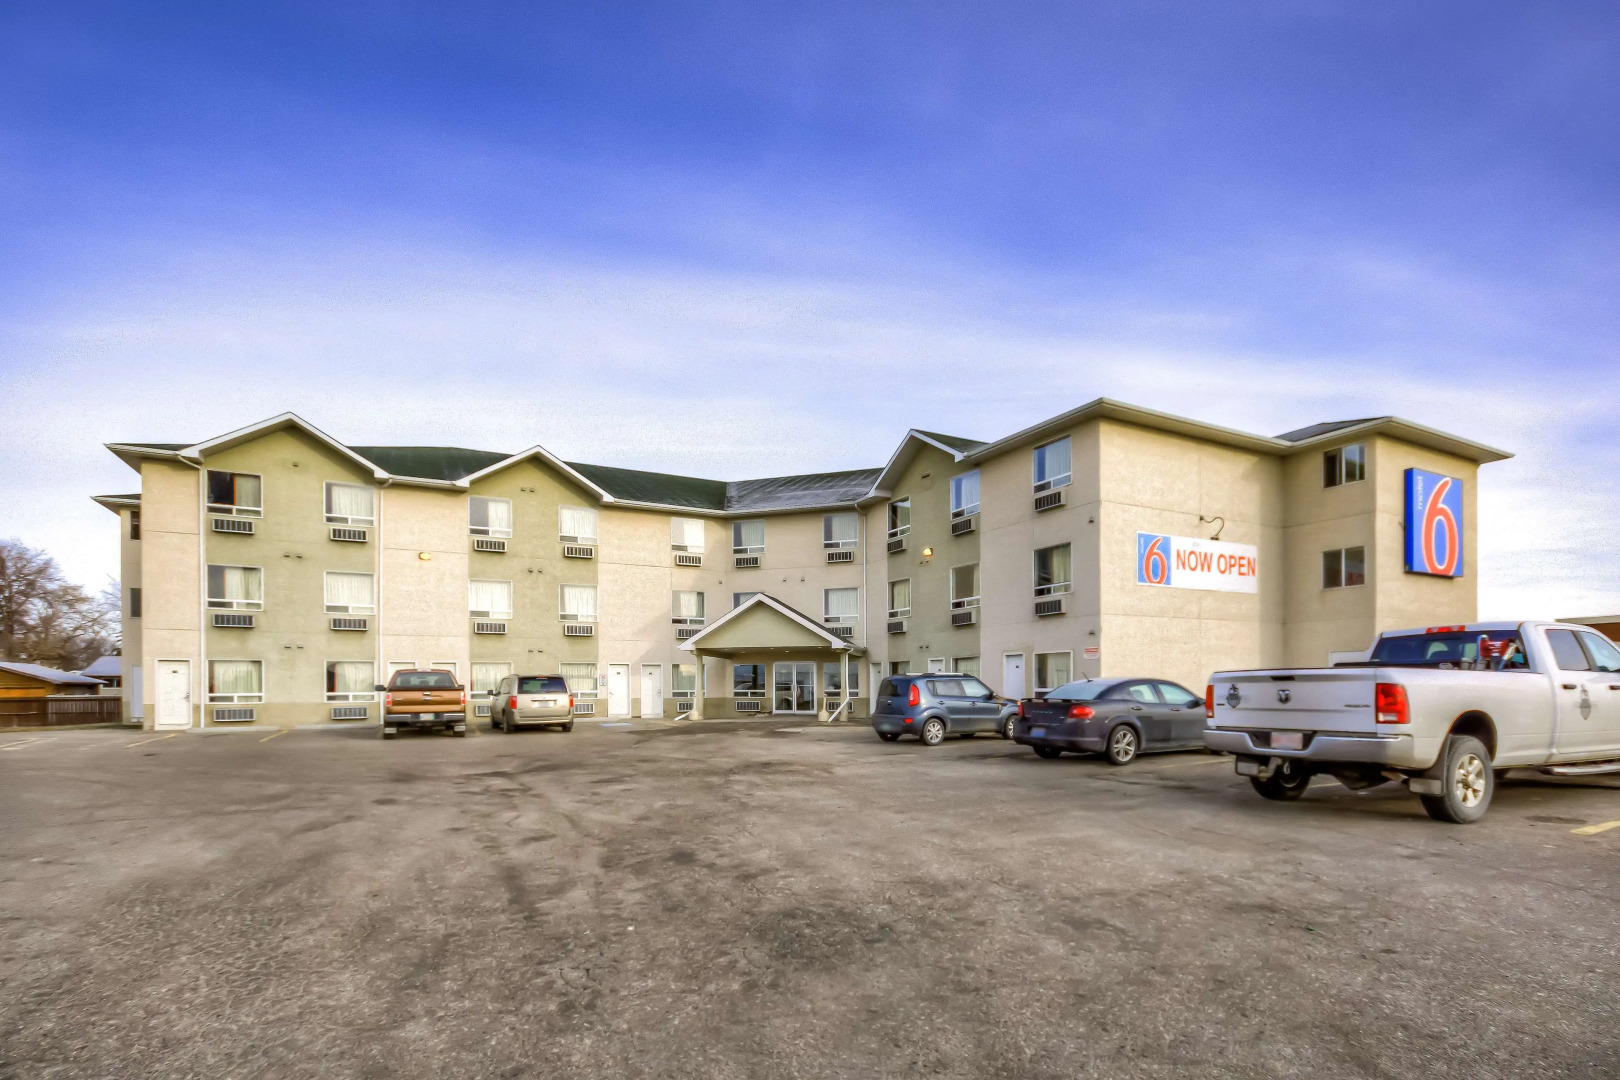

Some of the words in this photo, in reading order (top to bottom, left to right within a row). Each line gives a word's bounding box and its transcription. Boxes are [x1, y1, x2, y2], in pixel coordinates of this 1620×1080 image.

[1421, 477, 1459, 575] 6
[1143, 537, 1168, 584] 6
[1176, 549, 1213, 572] NOW
[1217, 554, 1256, 576] OPEN
